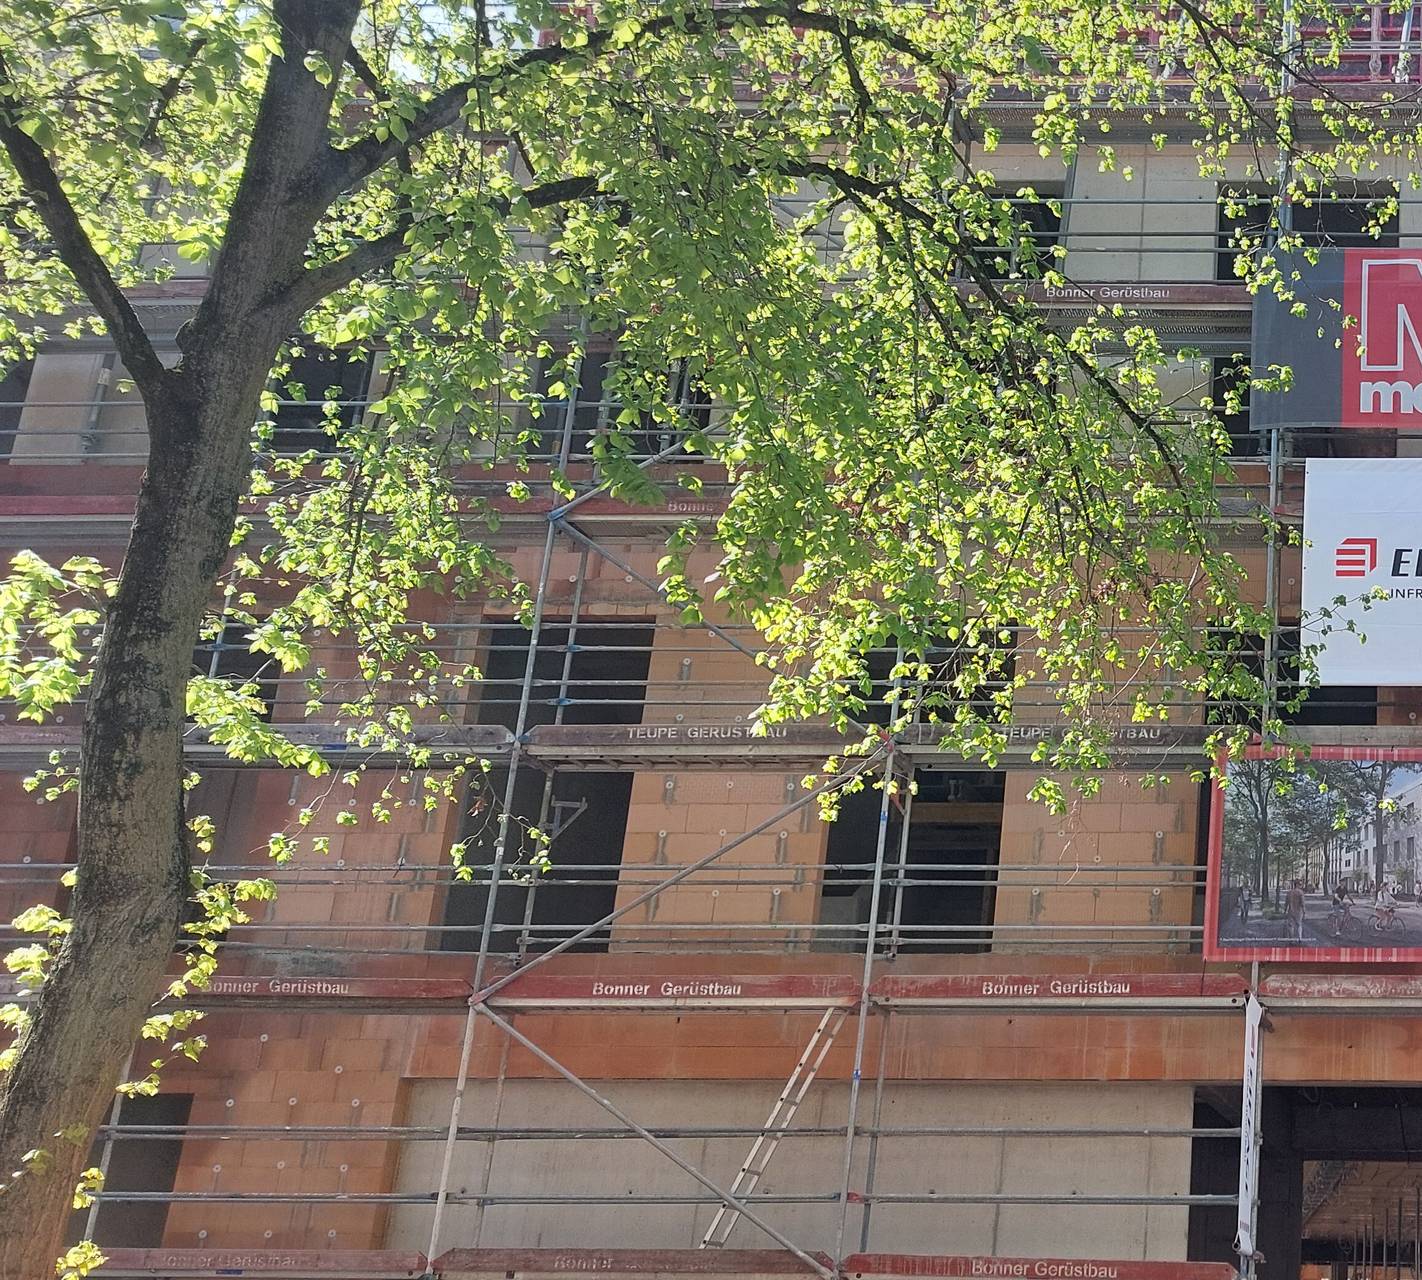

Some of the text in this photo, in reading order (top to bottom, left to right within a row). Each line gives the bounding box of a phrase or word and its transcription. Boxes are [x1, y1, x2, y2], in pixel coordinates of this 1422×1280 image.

[1046, 286, 1170, 298] Bonner Gerüstbau
[627, 727, 788, 739] TEUPE GERUSTAU
[269, 979, 350, 994] Gerüstbau
[592, 981, 742, 996] Bonner Gerüstbau
[982, 980, 1130, 995] Bonner Gerüstbau
[972, 1259, 1118, 1278] Bonner Gerüstbau
